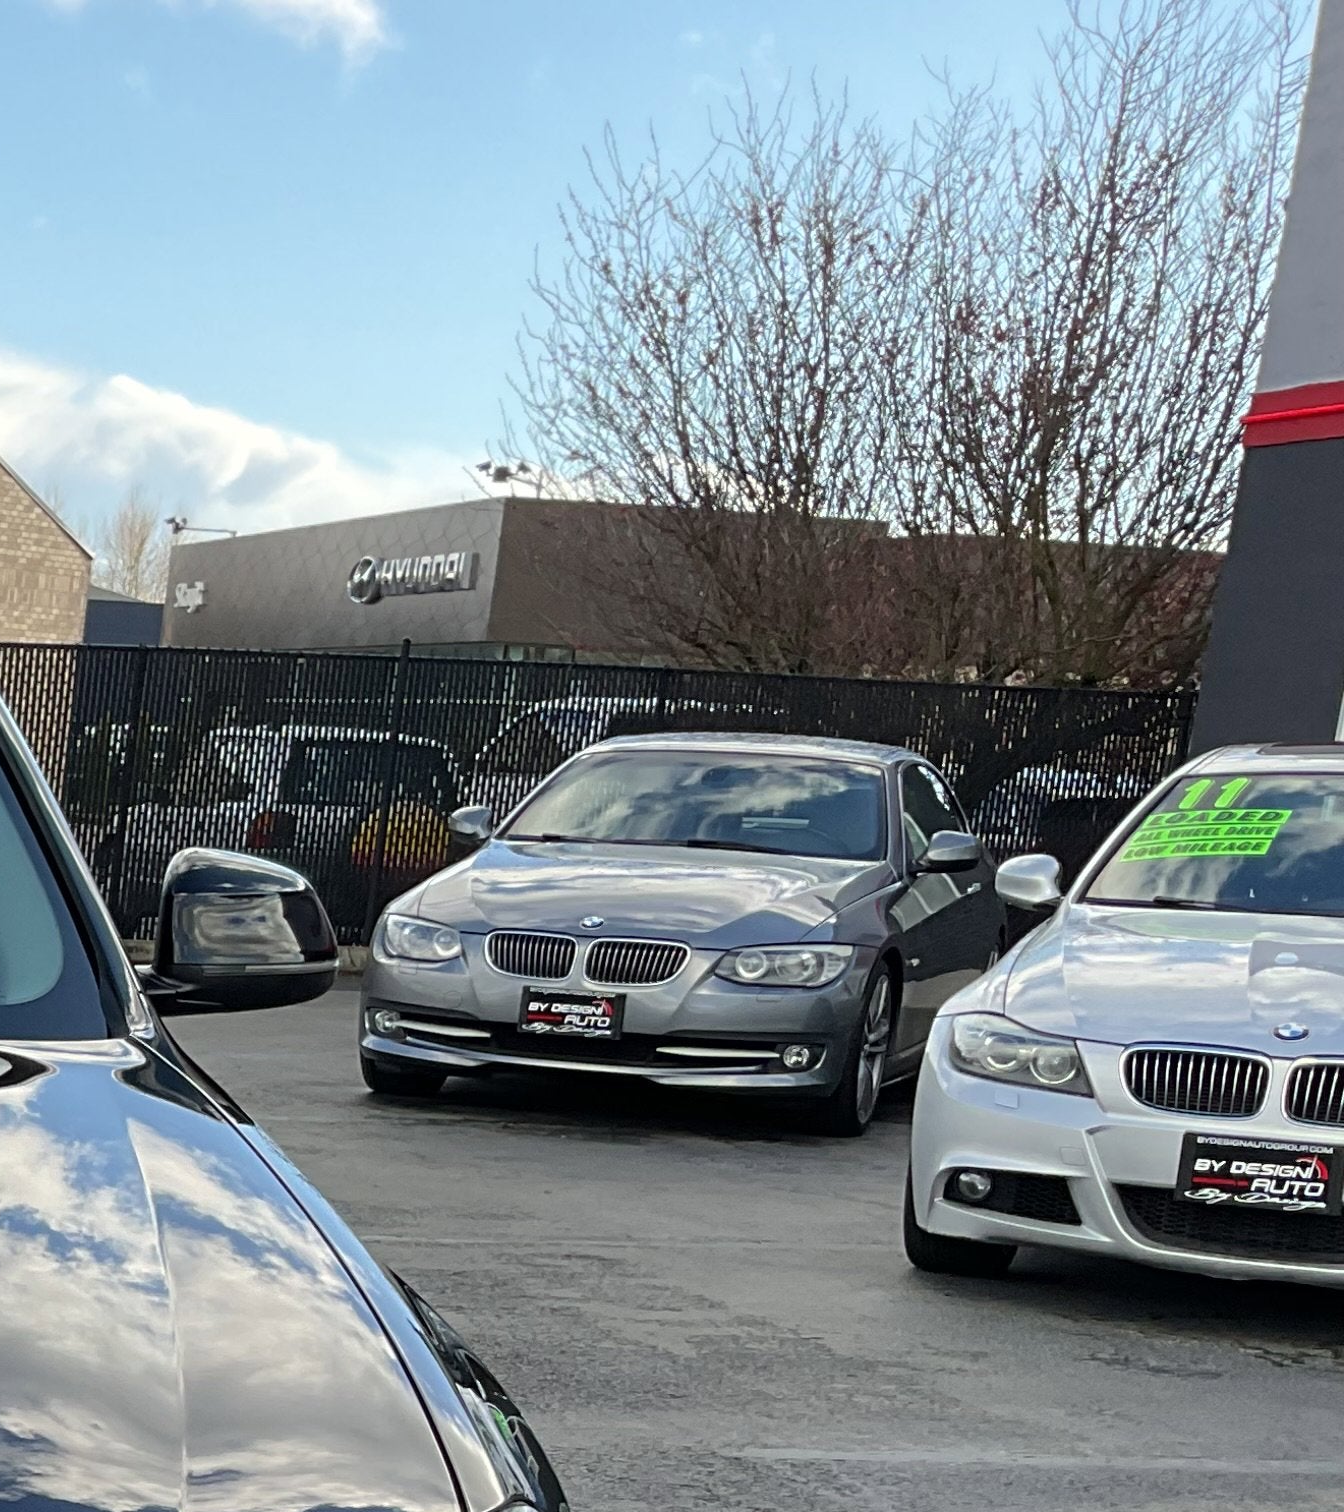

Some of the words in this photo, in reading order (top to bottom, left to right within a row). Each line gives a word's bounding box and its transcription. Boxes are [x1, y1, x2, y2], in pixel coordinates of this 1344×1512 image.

[380, 551, 469, 588] HYUNDAI
[1146, 811, 1284, 827] LOADED
[1133, 830, 1163, 843] ALL
[1168, 828, 1221, 839] WHEEL
[1223, 826, 1278, 836] DRIVE
[1123, 846, 1168, 860] LOW
[1171, 841, 1268, 855] MILEAGE
[528, 1002, 549, 1012] BY
[564, 1014, 611, 1028] AUTO
[1193, 1158, 1226, 1172] BY
[1250, 1178, 1325, 1197] AUTO
